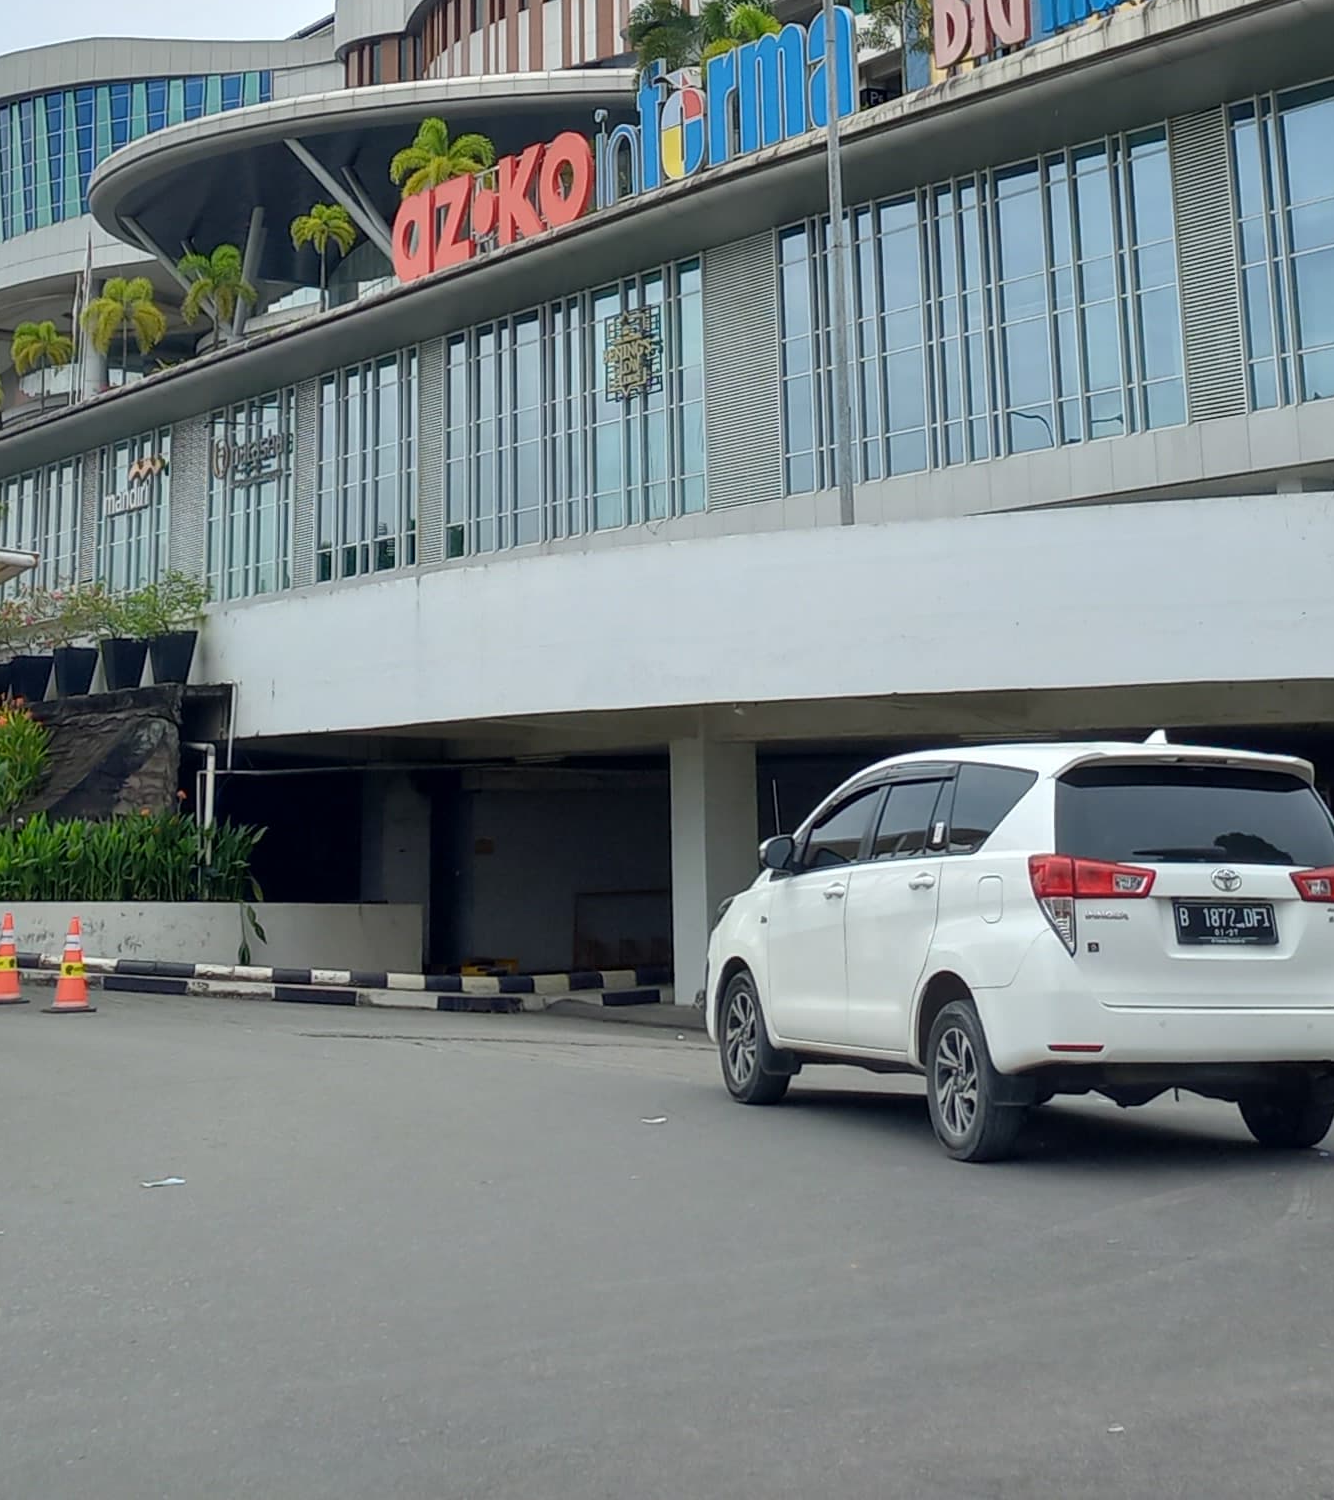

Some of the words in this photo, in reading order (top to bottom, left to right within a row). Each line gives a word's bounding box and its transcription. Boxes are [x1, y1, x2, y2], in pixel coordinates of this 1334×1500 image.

[595, 5, 857, 210] informa
[1179, 907, 1189, 927] B
[1203, 907, 1236, 927] 1872
